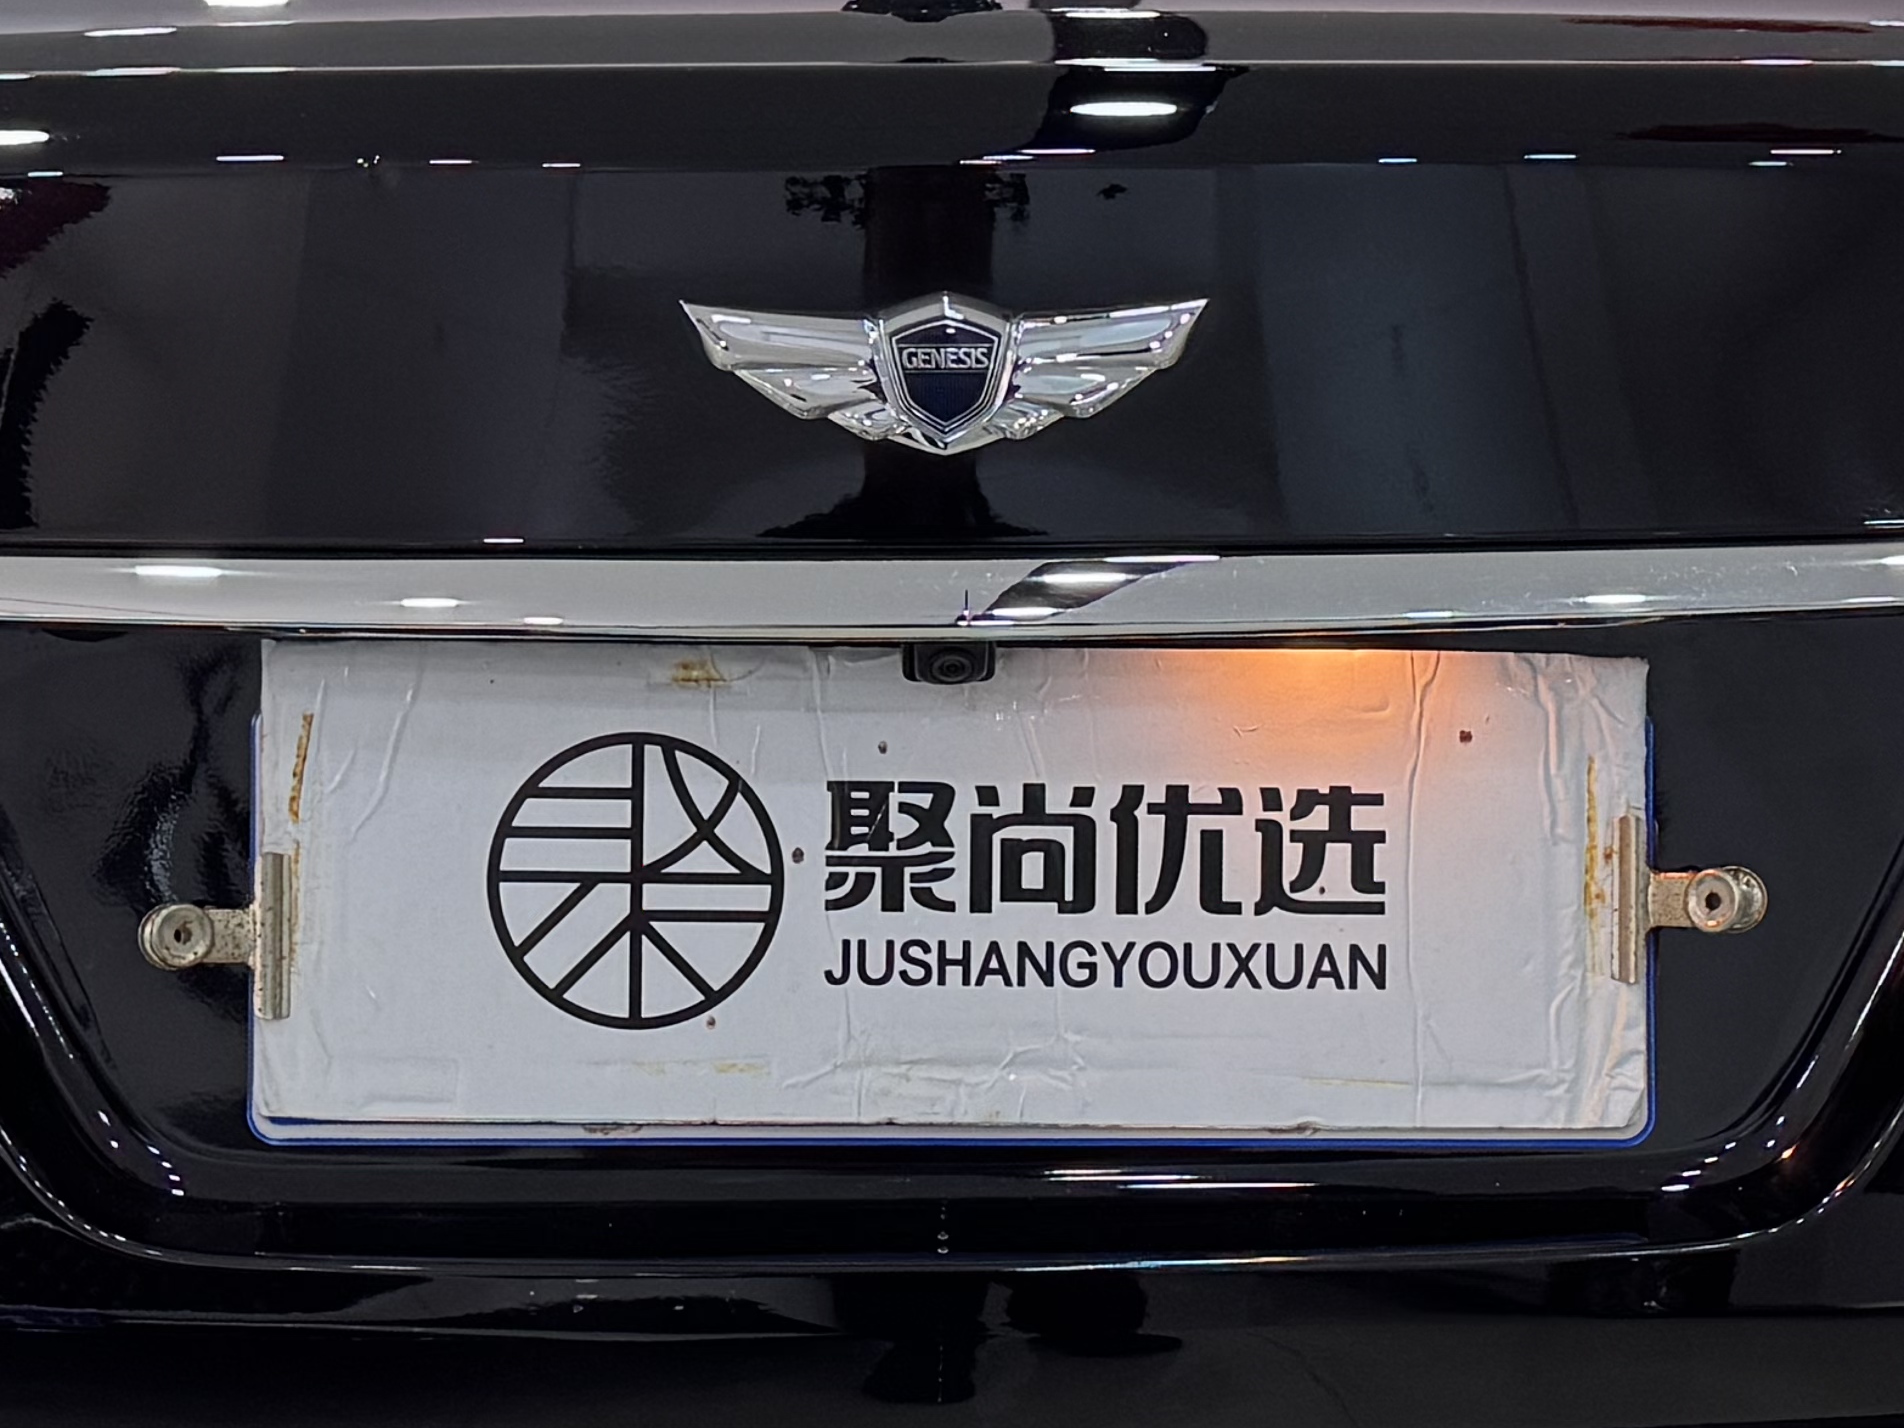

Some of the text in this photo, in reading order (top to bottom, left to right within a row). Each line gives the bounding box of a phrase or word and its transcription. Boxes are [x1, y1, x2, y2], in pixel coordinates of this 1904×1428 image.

[902, 347, 989, 369] GENESIS
[824, 780, 1388, 916] 聚尚优选
[823, 939, 1388, 991] JUSHANGYOUXUAN
